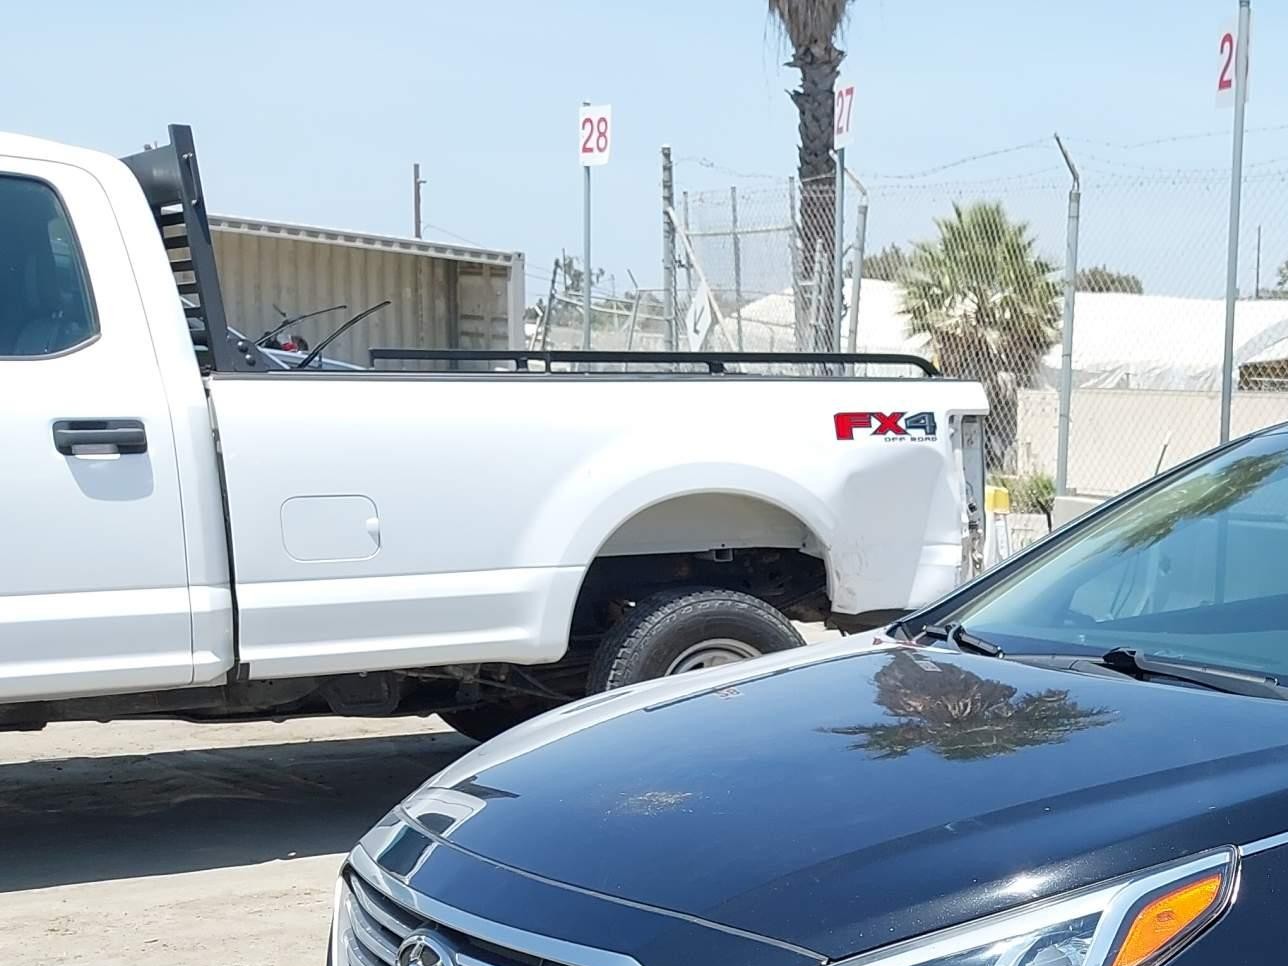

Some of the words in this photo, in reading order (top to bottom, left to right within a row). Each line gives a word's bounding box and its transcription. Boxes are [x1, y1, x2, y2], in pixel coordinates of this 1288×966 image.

[835, 86, 855, 135] 27
[581, 117, 608, 153] 28
[833, 411, 938, 441] FX4
